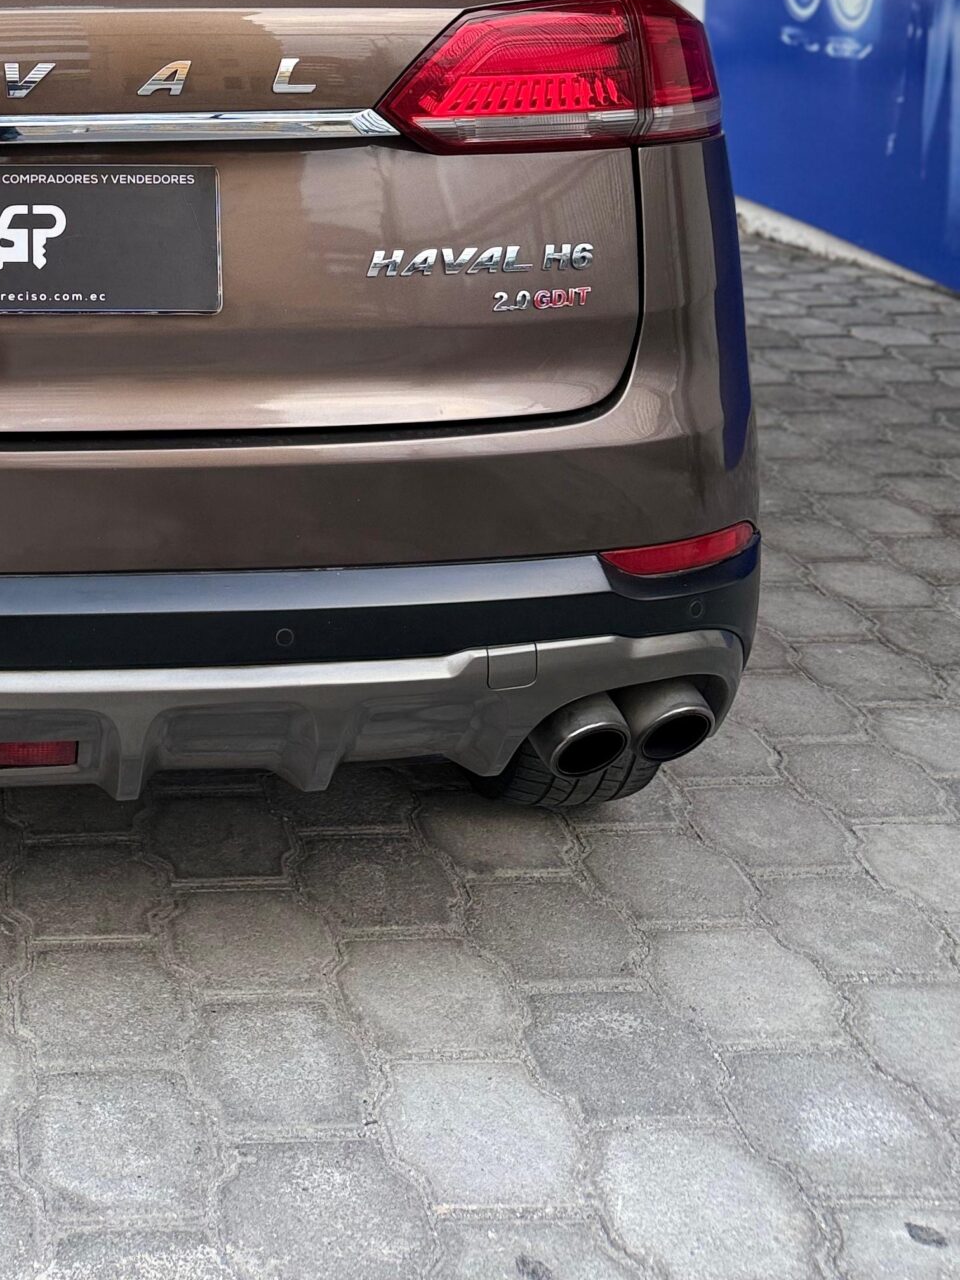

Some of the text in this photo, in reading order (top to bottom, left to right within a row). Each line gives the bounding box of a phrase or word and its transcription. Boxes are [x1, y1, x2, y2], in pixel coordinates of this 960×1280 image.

[2, 174, 98, 184] COMPRADORES
[101, 174, 109, 184] Y
[111, 174, 195, 184] VENDEDORES
[366, 243, 594, 278] HAVAL H6
